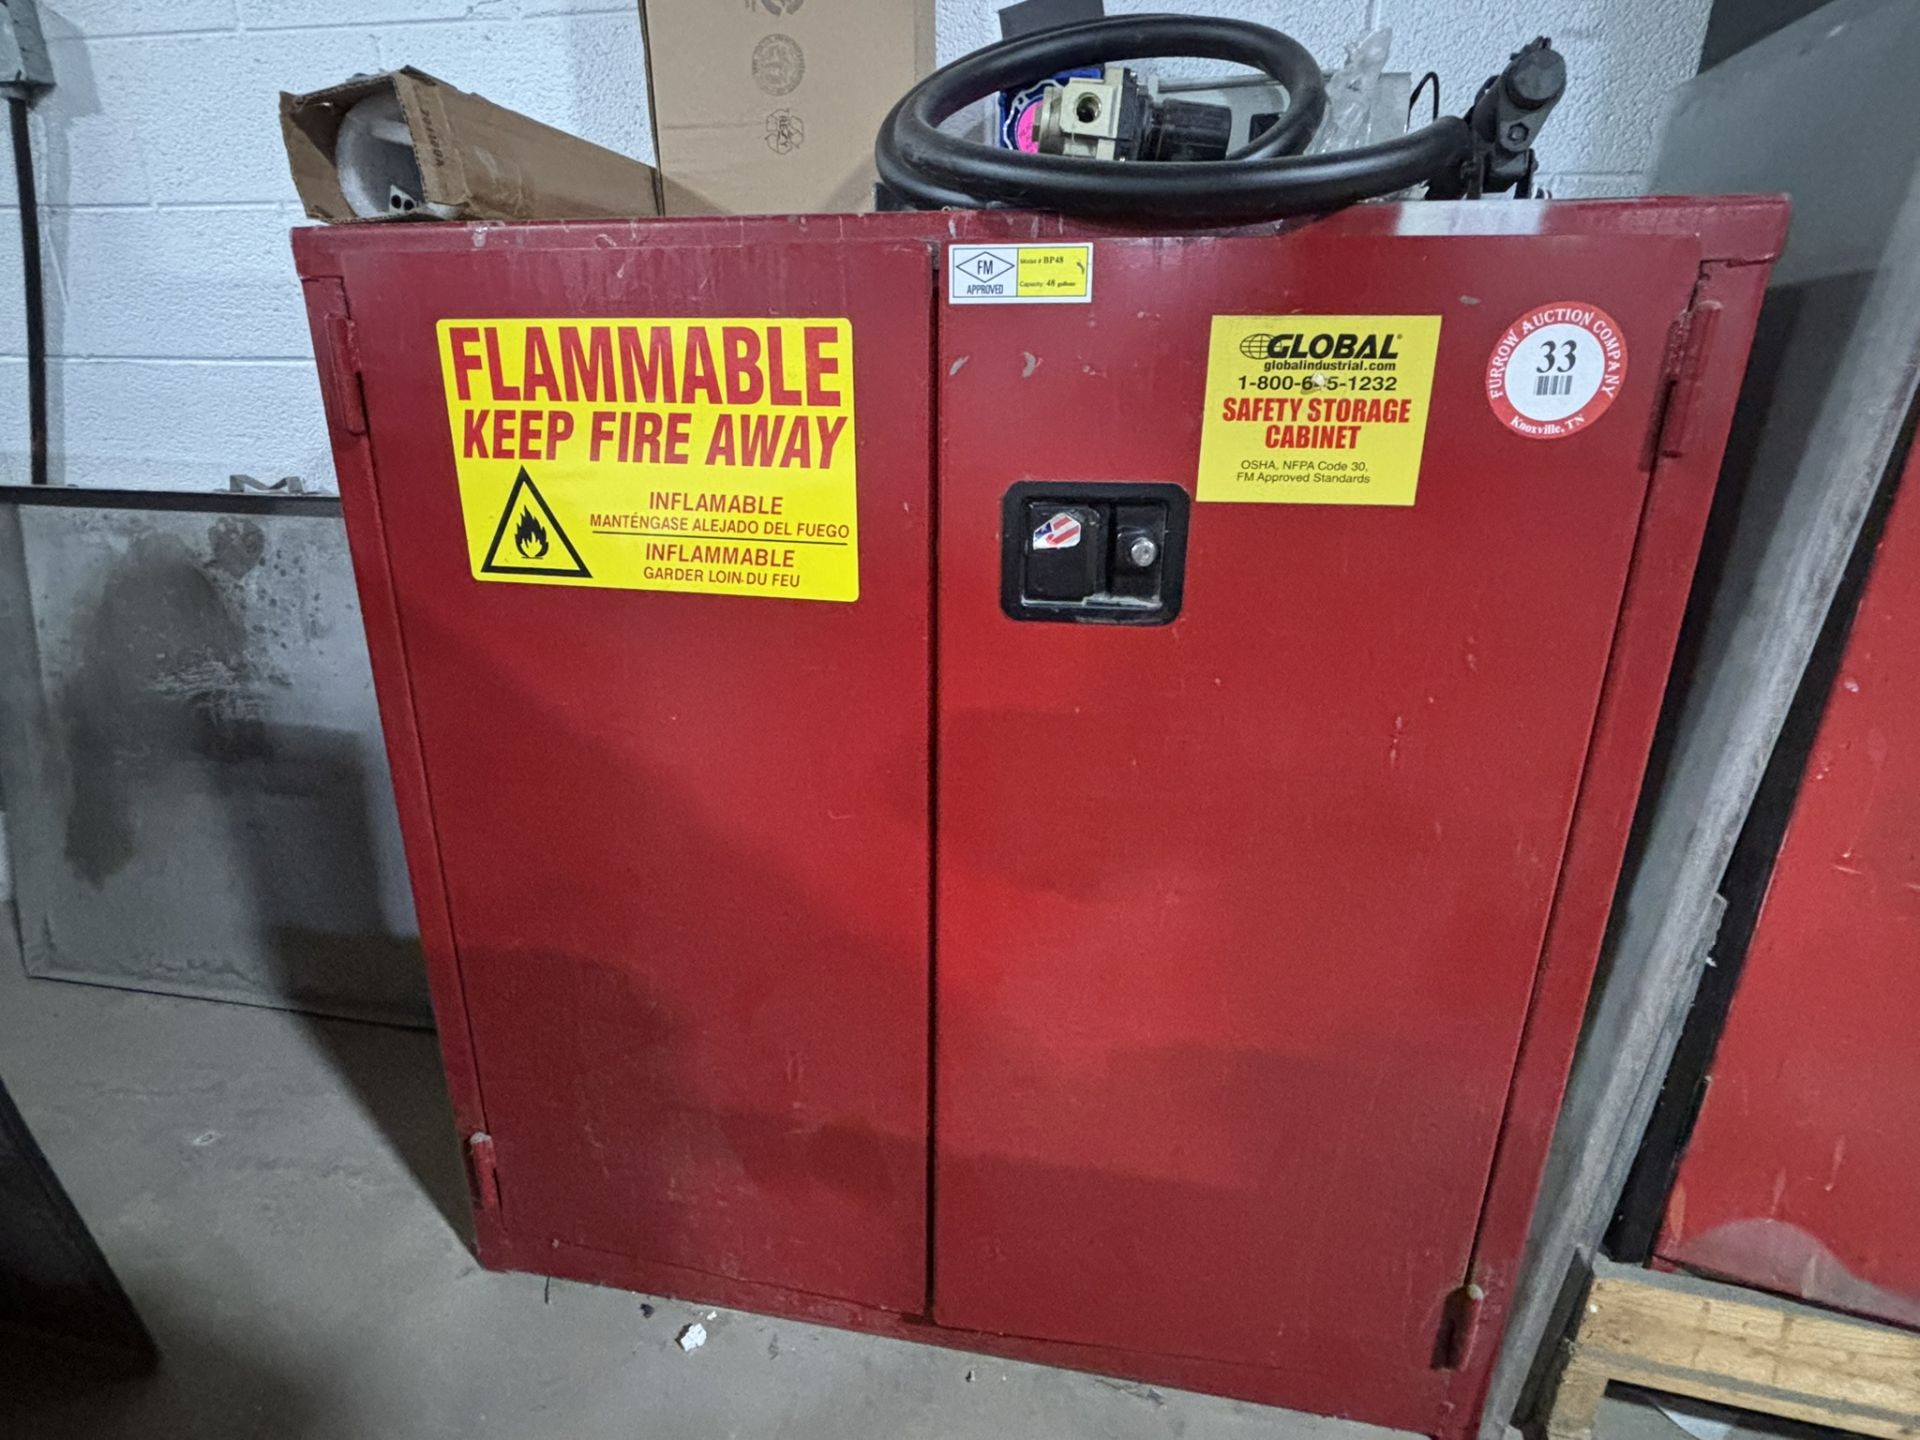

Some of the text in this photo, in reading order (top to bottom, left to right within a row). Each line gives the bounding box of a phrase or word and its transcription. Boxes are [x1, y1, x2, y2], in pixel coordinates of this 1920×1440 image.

[977, 260, 993, 275] FM
[1043, 256, 1064, 264] BP48
[967, 284, 1004, 295] APPROVED
[1046, 279, 1056, 287] 48
[1267, 334, 1399, 359] GLOBAL
[1488, 308, 1622, 399] FURROW AUCTION COMPANY
[1536, 340, 1577, 373] 33
[449, 326, 841, 407] FLAMMABLE
[1264, 360, 1396, 372] globalindustrial.com
[1238, 375, 1397, 391] 1-800-65-1232
[1222, 397, 1412, 423] SAFETY STORAGE
[1564, 414, 1585, 429] TN
[463, 409, 848, 469] KEEP FIRE AWAY
[1265, 424, 1361, 449] CABINET
[1241, 459, 1279, 471] OSHA,
[1282, 460, 1315, 470] NFPA
[1317, 461, 1348, 471] Code
[1236, 472, 1371, 483] FM Approved Standards
[649, 491, 784, 515] INFLAMABLE
[590, 512, 849, 538] MANTÉNGASE ALEJADO DEL FUEGO
[645, 543, 795, 568] INFLAMMABLE
[643, 566, 800, 587] GARDER LOIN DU FEU
